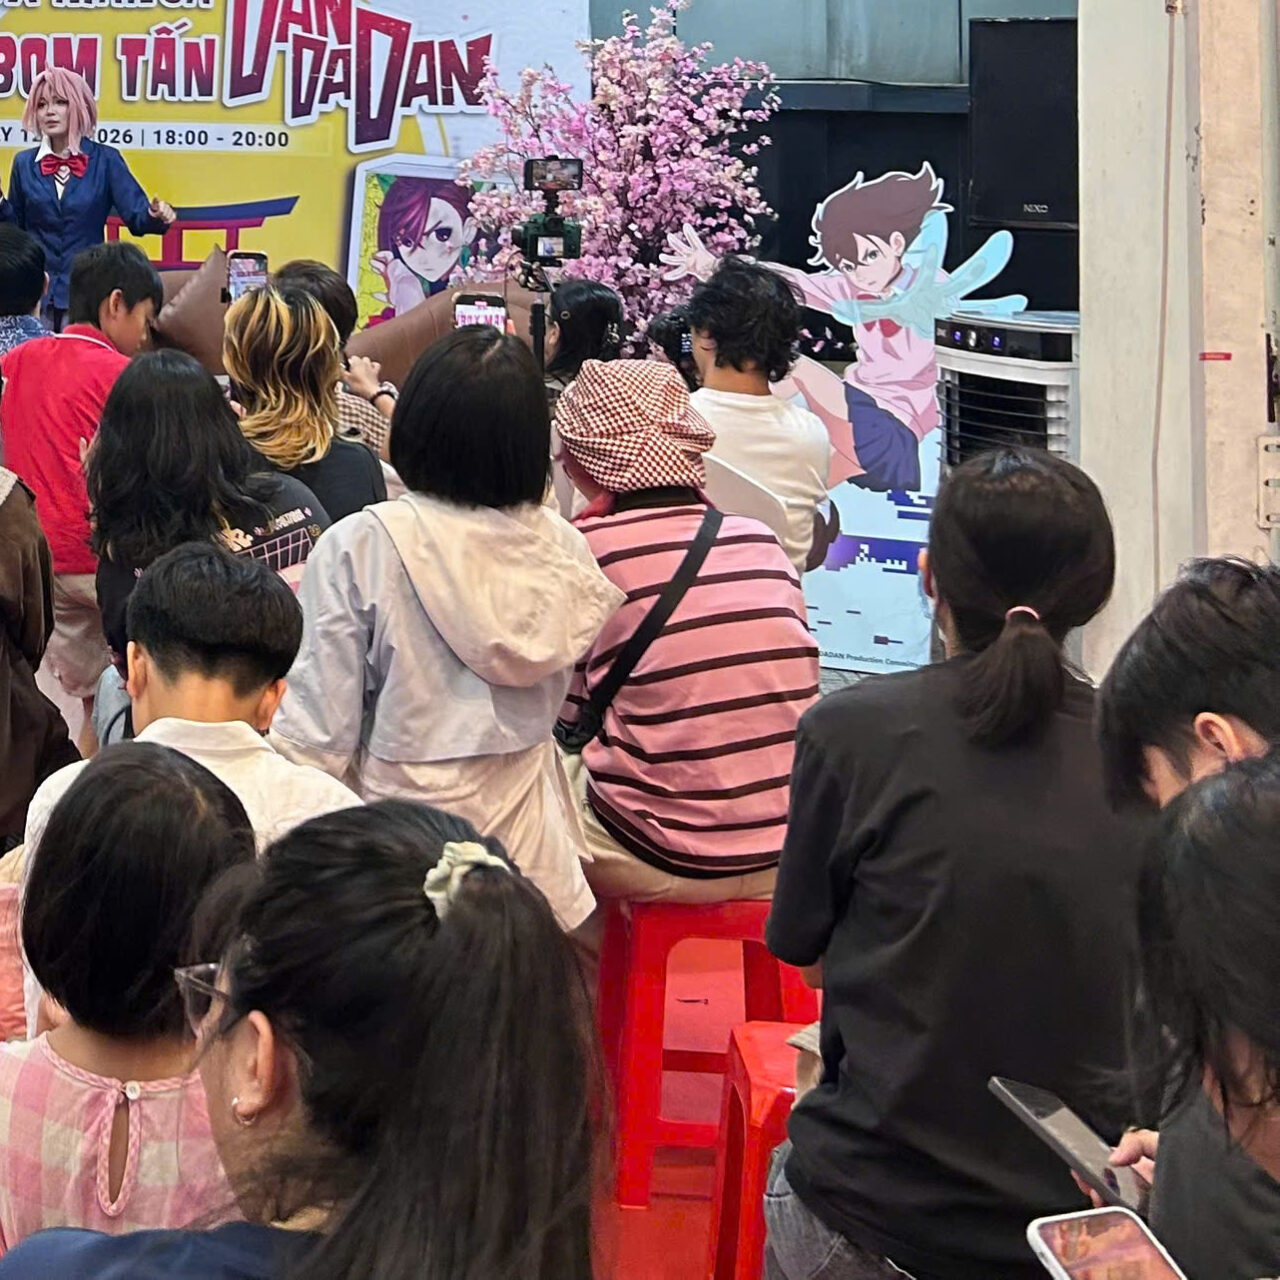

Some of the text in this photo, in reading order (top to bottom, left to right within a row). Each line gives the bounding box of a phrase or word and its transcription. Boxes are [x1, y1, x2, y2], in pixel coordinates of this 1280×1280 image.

[121, 21, 216, 97] TẤN
[154, 129, 210, 146] 18:00
[232, 131, 289, 147] 20:00
